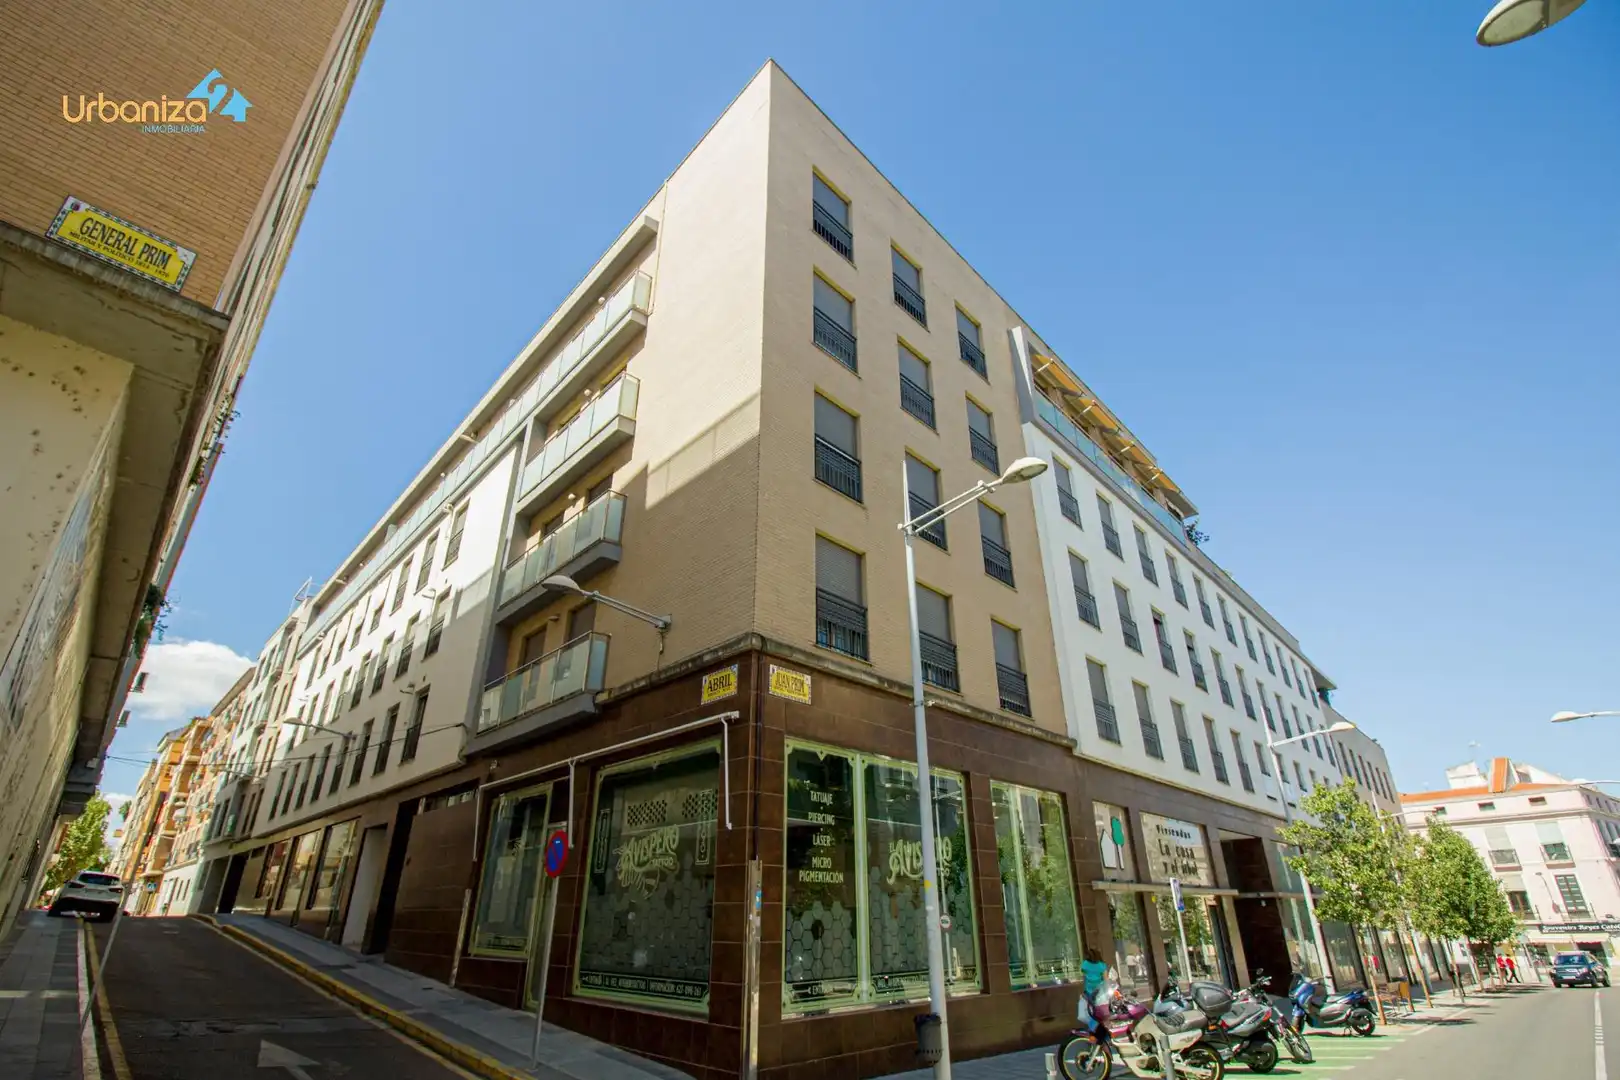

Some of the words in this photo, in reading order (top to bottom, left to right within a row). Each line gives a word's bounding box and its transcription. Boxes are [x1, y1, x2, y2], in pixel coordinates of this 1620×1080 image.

[80, 217, 138, 256] GENERAL
[138, 242, 172, 270] PRIM
[707, 673, 732, 692] ABRIL
[775, 672, 790, 690] JUAN
[810, 790, 833, 806] TATUAJE
[808, 812, 835, 826] PIERCING
[1156, 824, 1191, 839] Viviendas
[813, 832, 831, 847] LÁSER
[1158, 838, 1171, 856] La
[812, 856, 832, 869] MICRO
[799, 870, 844, 883] PIGMENTACIÓN
